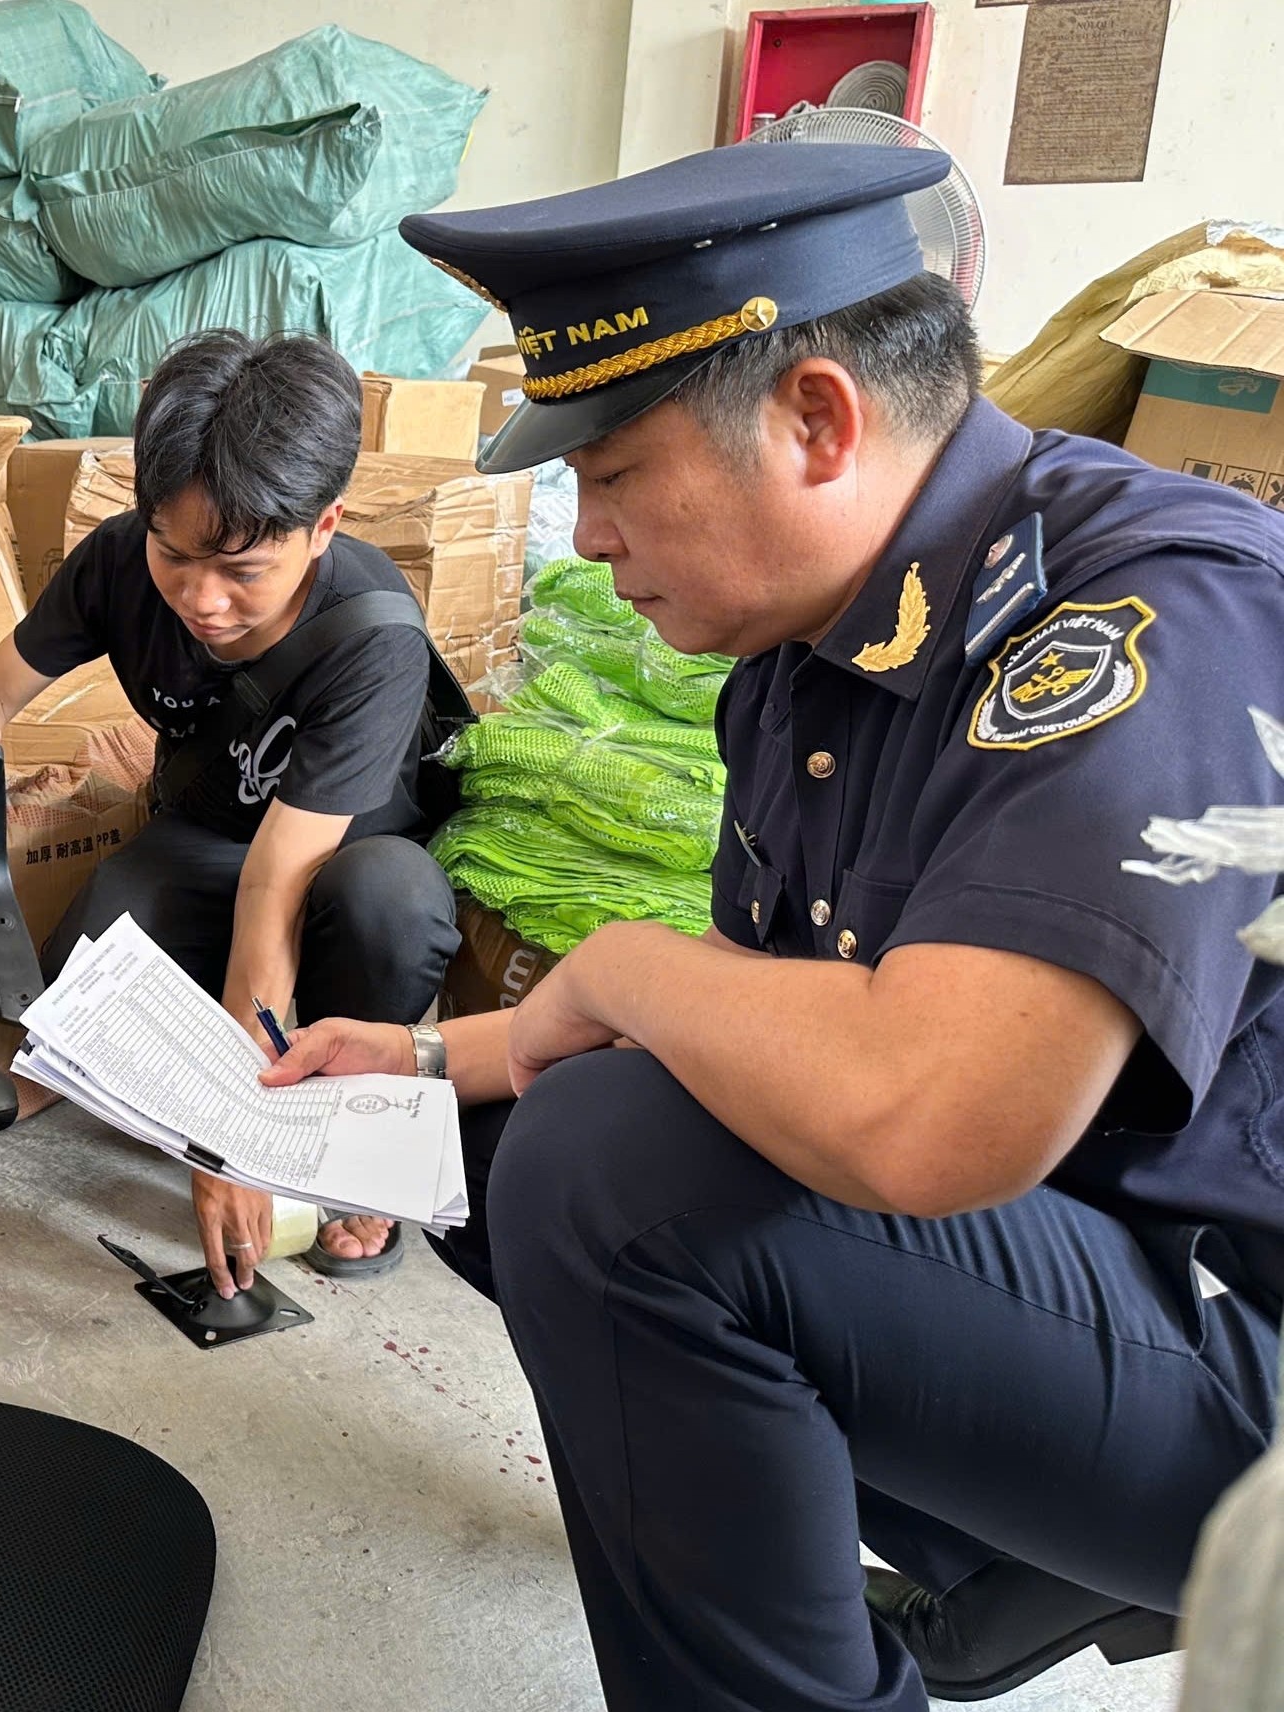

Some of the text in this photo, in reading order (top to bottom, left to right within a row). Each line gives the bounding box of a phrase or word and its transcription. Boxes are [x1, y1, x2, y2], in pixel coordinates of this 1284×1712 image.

[566, 306, 650, 346] NAM
[152, 687, 194, 708] YOU
[1029, 714, 1092, 734] CUSTOMS
